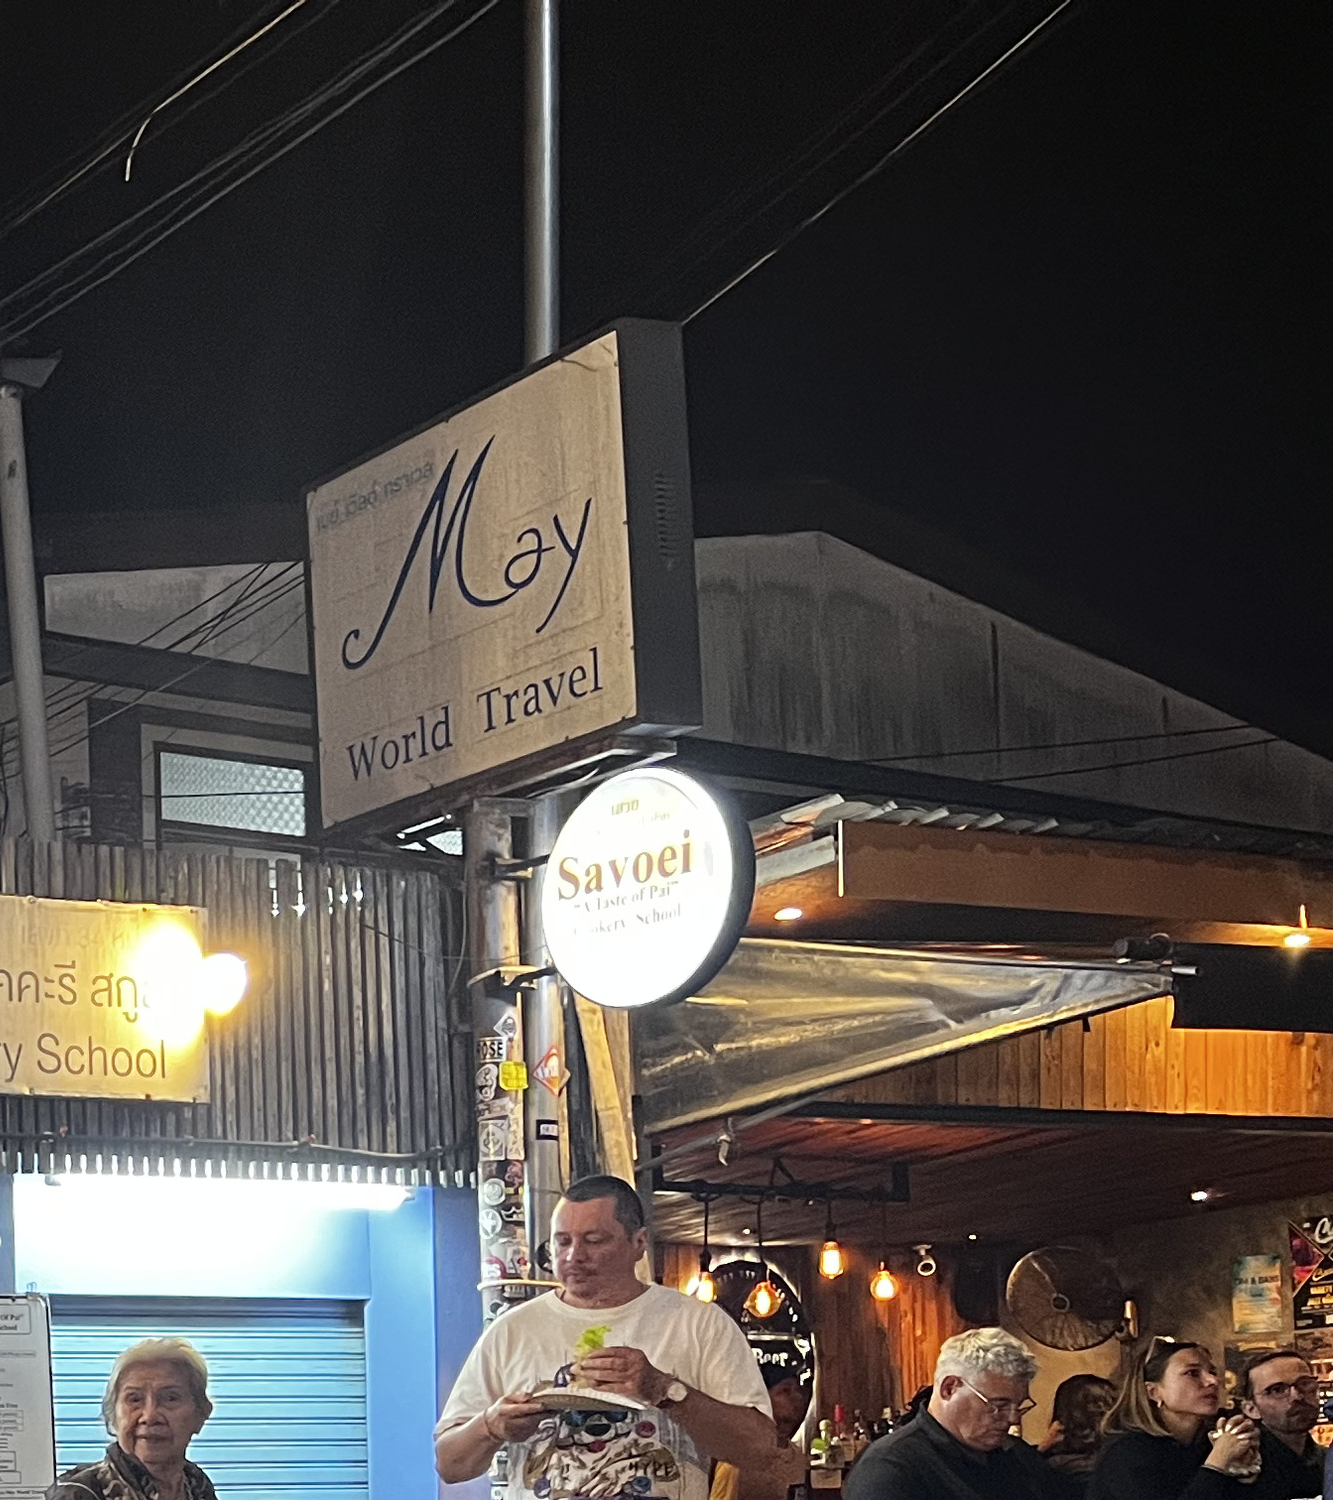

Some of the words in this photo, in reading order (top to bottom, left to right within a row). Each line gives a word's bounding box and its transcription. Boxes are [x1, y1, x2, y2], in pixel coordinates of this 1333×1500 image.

[341, 434, 593, 670] May
[345, 705, 453, 782] World
[475, 647, 605, 735] Travel
[558, 829, 691, 901] Savoei
[36, 1033, 167, 1080] School
